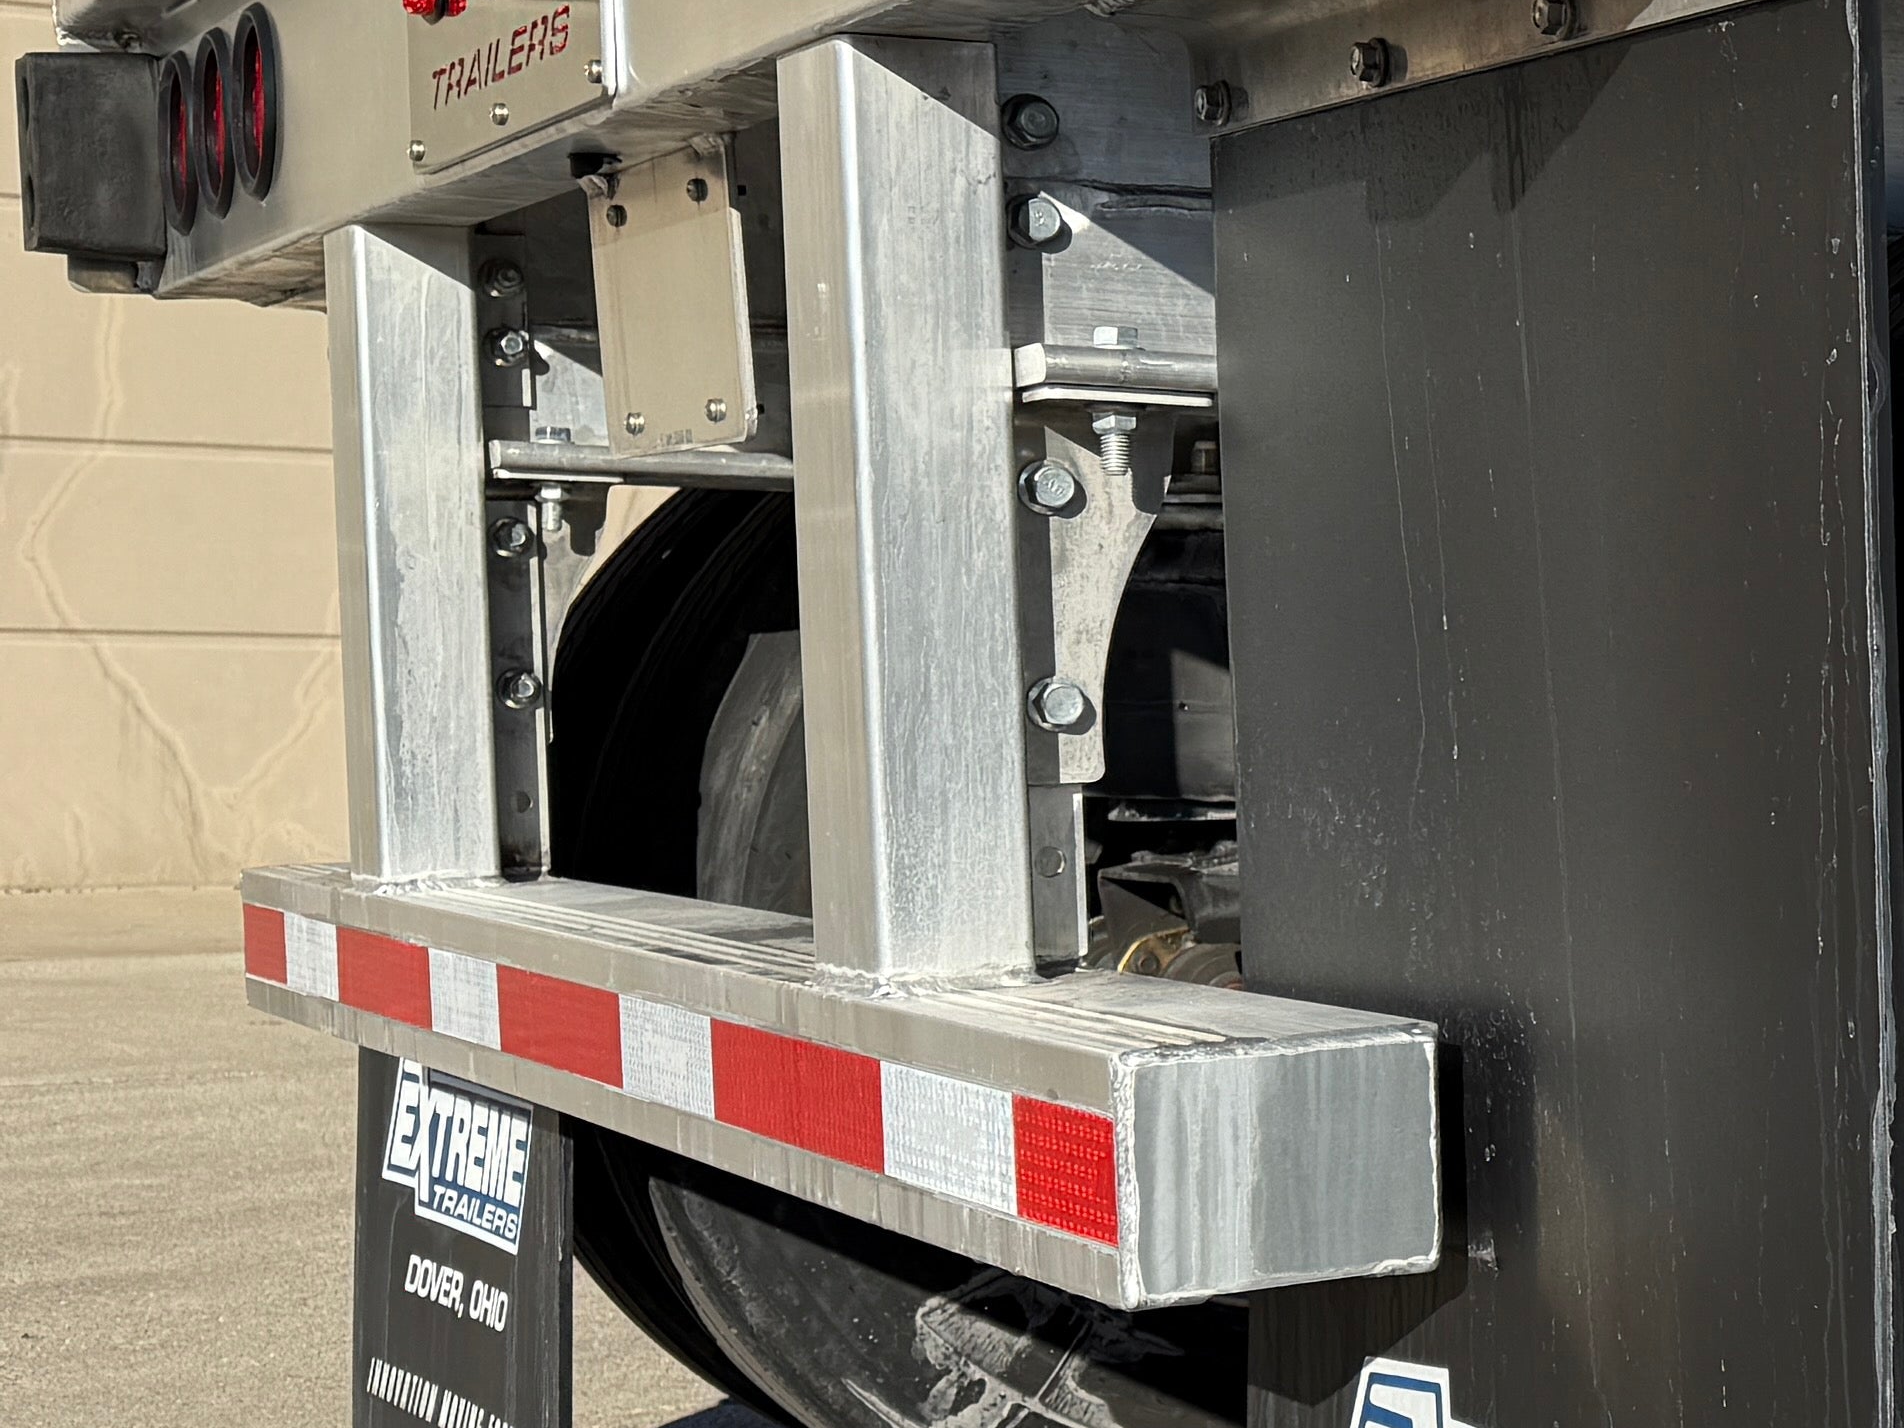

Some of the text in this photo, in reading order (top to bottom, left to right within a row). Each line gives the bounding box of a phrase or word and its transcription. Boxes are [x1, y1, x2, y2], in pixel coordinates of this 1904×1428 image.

[430, 3, 571, 109] TRAILERS
[389, 1057, 528, 1209] EXTREME
[430, 1182, 518, 1241] TRAILERS
[404, 1253, 509, 1333] DOVER, OHIO
[366, 1356, 438, 1425] INNOVATION
